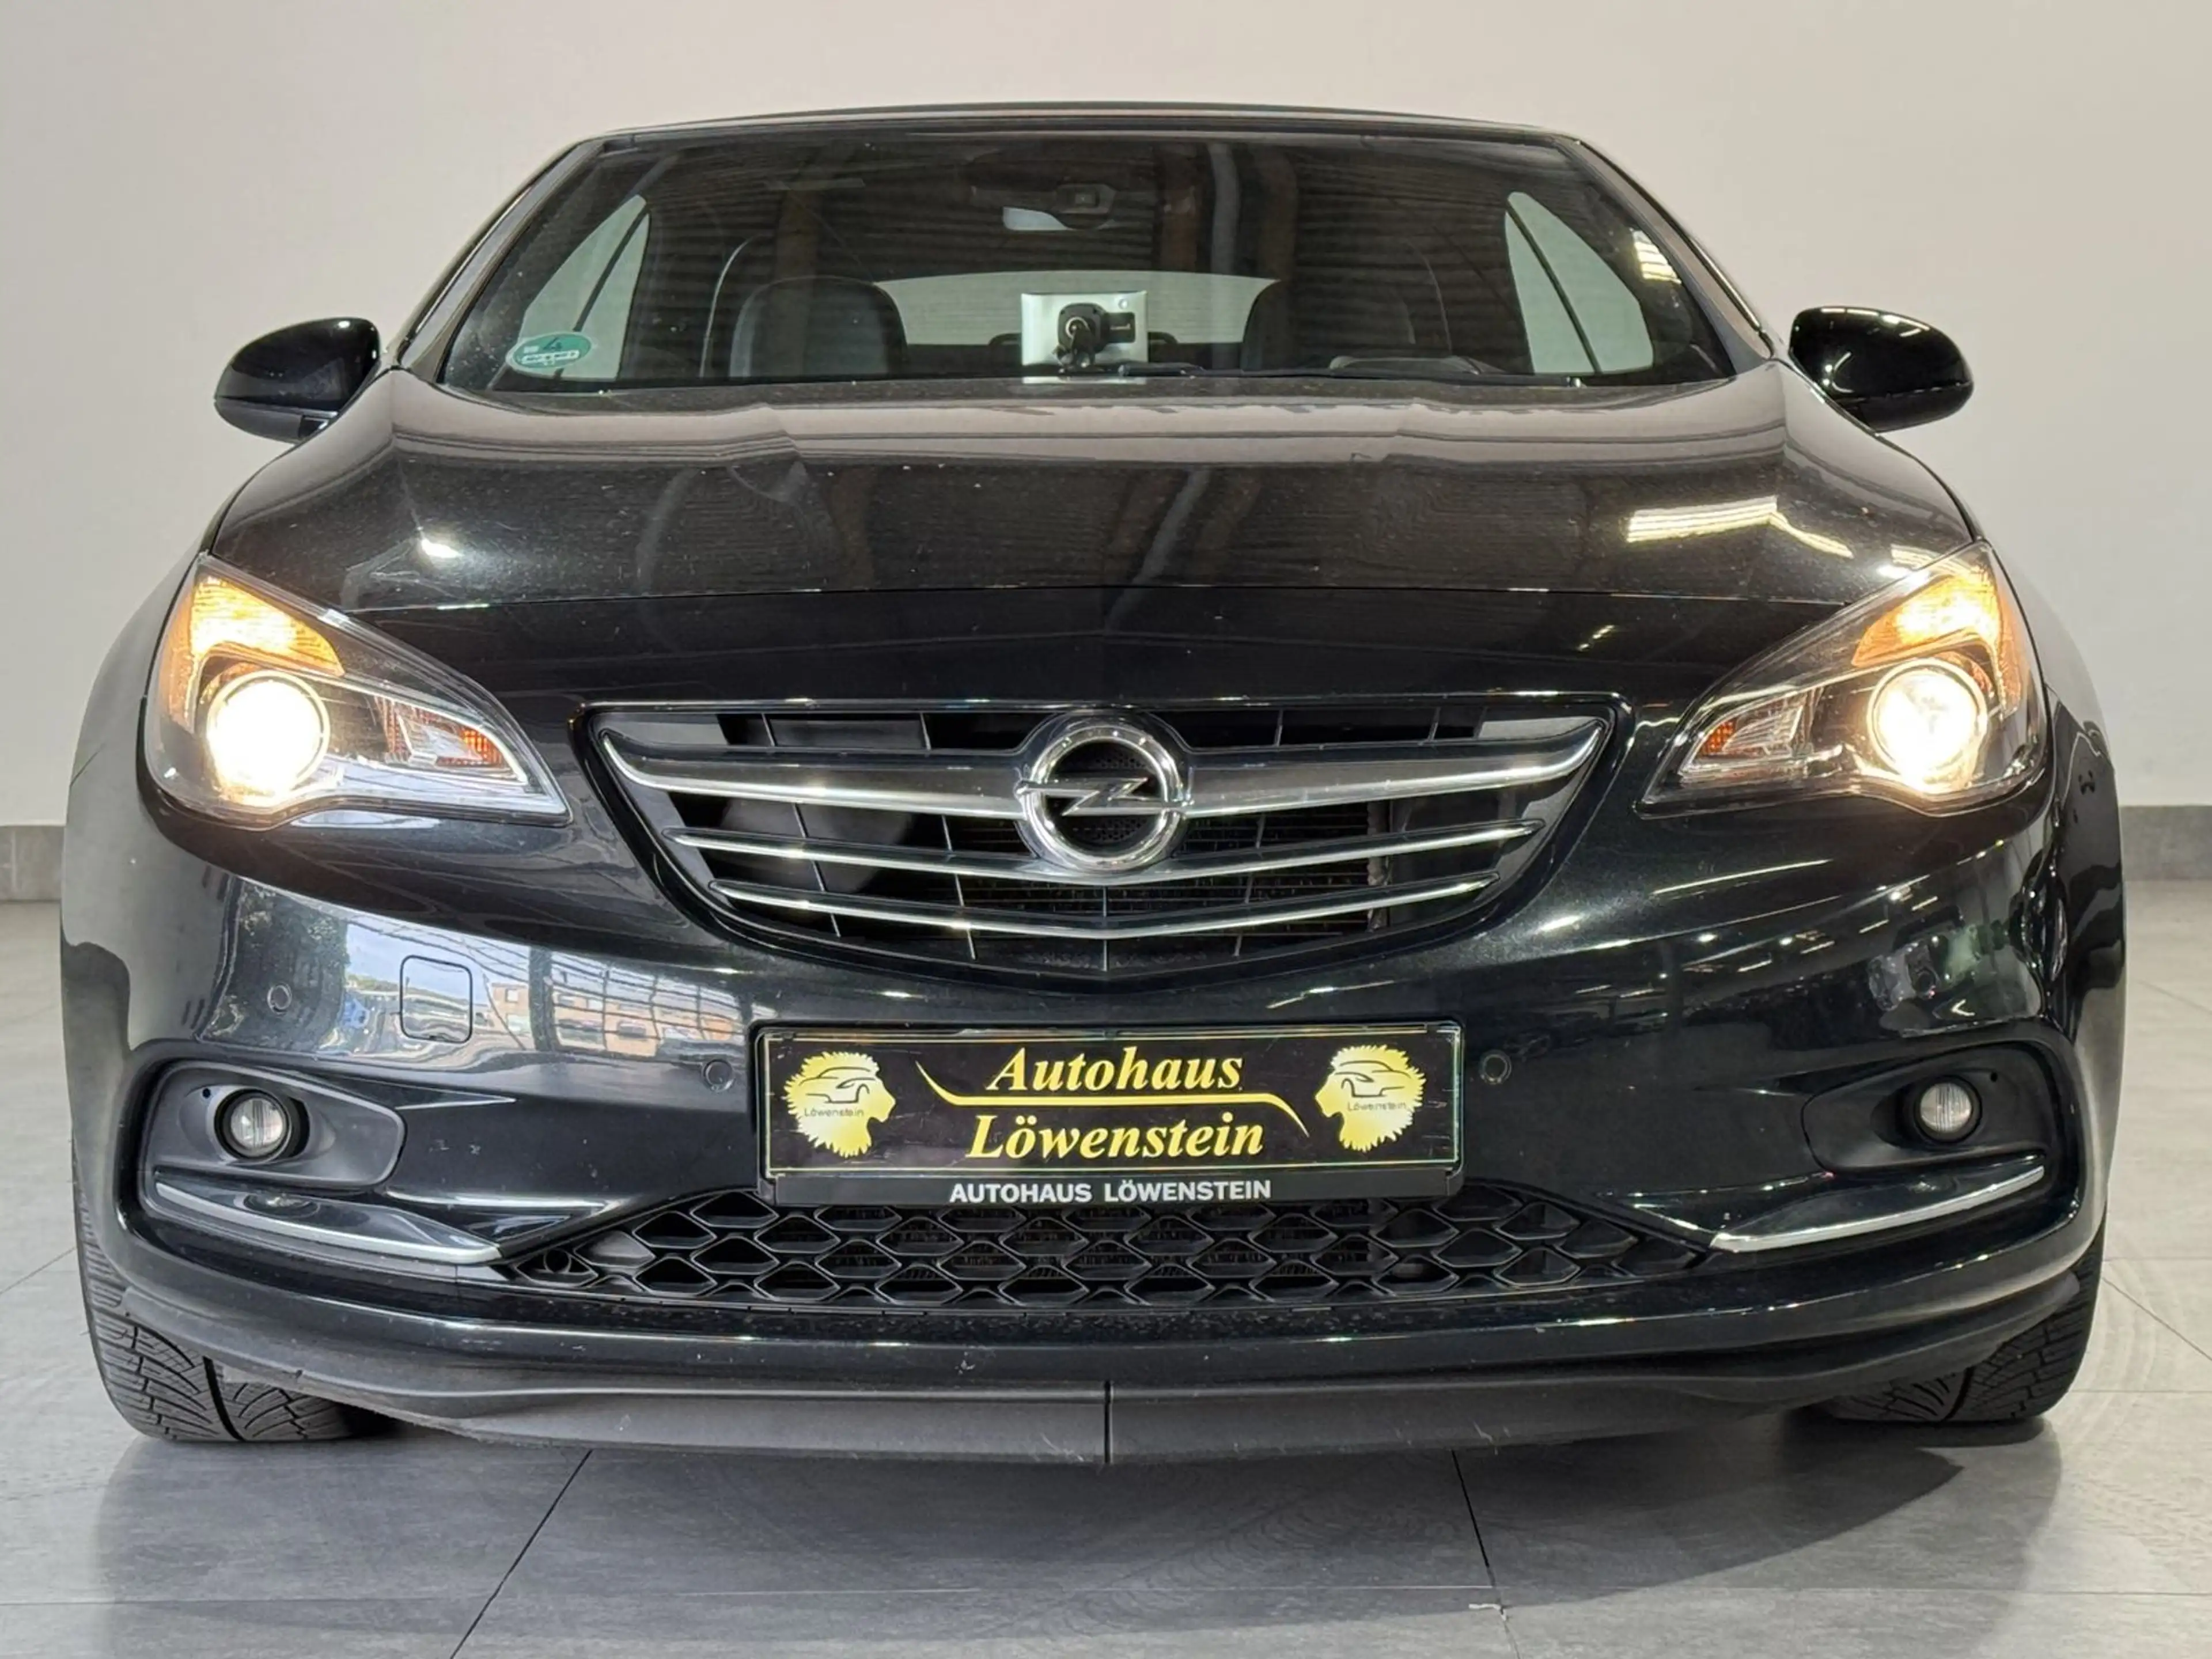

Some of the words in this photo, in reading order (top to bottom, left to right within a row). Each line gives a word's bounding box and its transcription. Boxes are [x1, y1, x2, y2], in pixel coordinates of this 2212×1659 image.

[985, 1046, 1243, 1092] Autohaus
[805, 1108, 864, 1118] Löwenstein
[965, 1111, 1264, 1159] Löwenstein
[949, 1182, 1092, 1203] AUTOHAUS
[1104, 1179, 1271, 1203] LÖWENSTEIN
